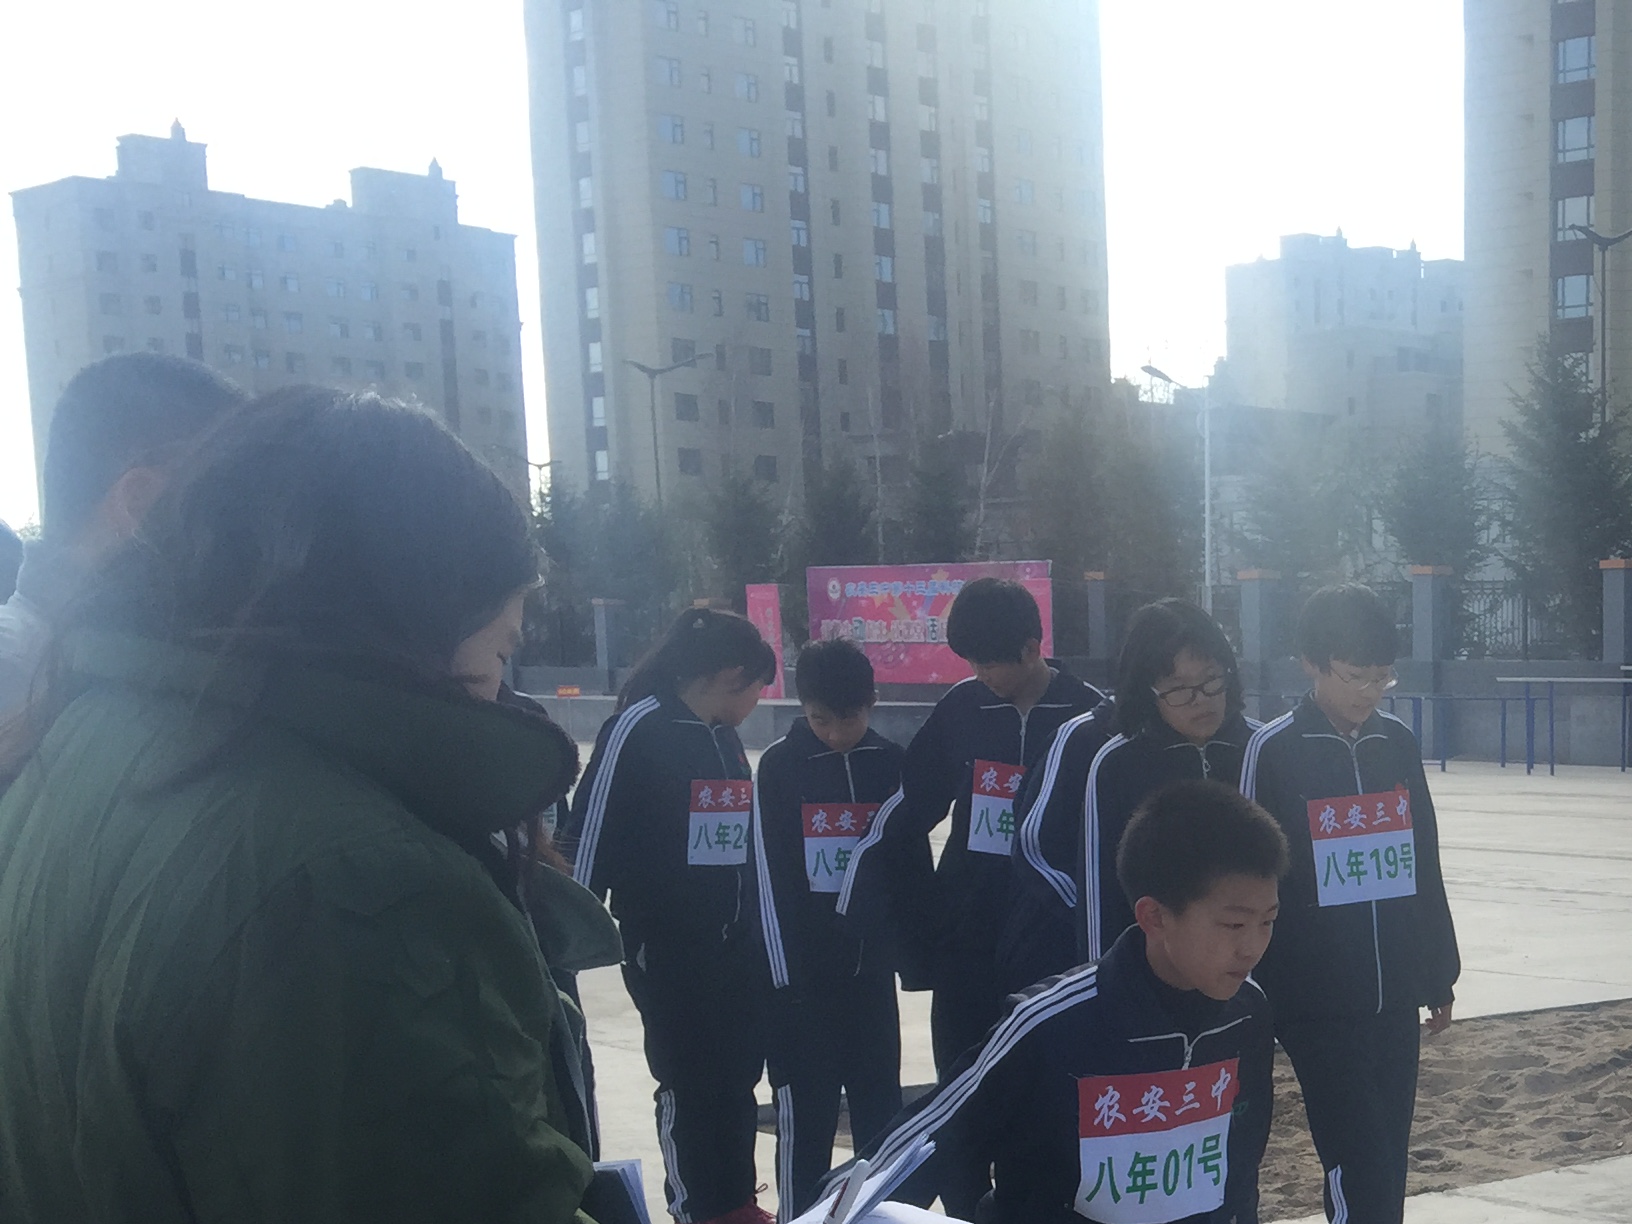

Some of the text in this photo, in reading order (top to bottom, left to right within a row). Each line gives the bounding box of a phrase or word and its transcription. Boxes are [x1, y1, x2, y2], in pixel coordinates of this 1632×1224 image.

[974, 807, 1015, 842] 八年
[1319, 795, 1408, 835] 农安三中
[1323, 842, 1413, 888] 八年19号
[1093, 1067, 1232, 1129] 农安三中
[1085, 1133, 1222, 1205] 八年01号
